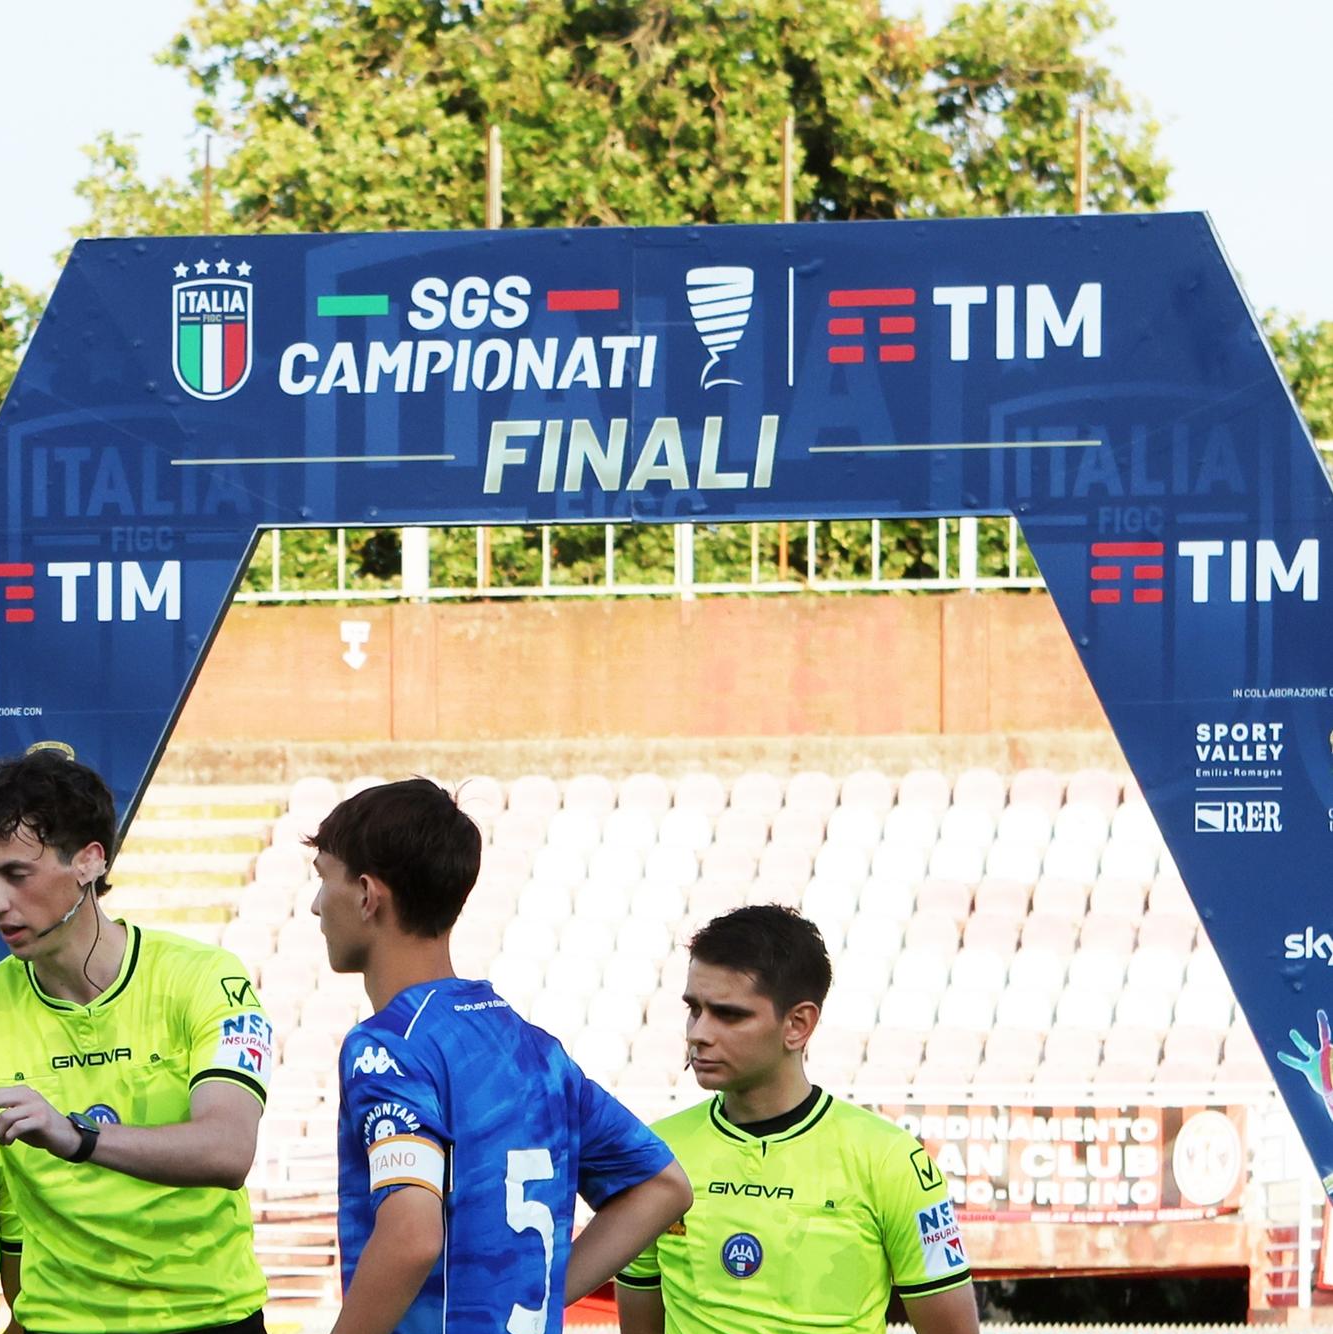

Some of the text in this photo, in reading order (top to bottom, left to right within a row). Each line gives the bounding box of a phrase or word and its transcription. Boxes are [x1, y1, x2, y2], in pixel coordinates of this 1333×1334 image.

[179, 289, 246, 313] ITALIA
[407, 275, 532, 331] SGS
[932, 282, 1102, 361] TIM
[279, 335, 657, 396] CAMPIONATI
[483, 413, 780, 494] FINALI
[1014, 424, 1249, 499] ITALIA
[31, 443, 255, 518] ITALIA
[112, 525, 176, 553] FIGC
[1177, 538, 1320, 604] TIM
[47, 560, 181, 622] TIM
[1232, 689, 1243, 698] IN
[1244, 687, 1327, 698] COLLABORAZIONE
[23, 707, 42, 716] CON
[1196, 723, 1284, 742] SPORT
[1195, 744, 1284, 762] VALLEY
[1195, 768, 1283, 779] Emilia-Romagna
[51, 1047, 132, 1070] GIVOVA
[1020, 1144, 1159, 1178] CLUB
[708, 1181, 794, 1200] GIVOVA
